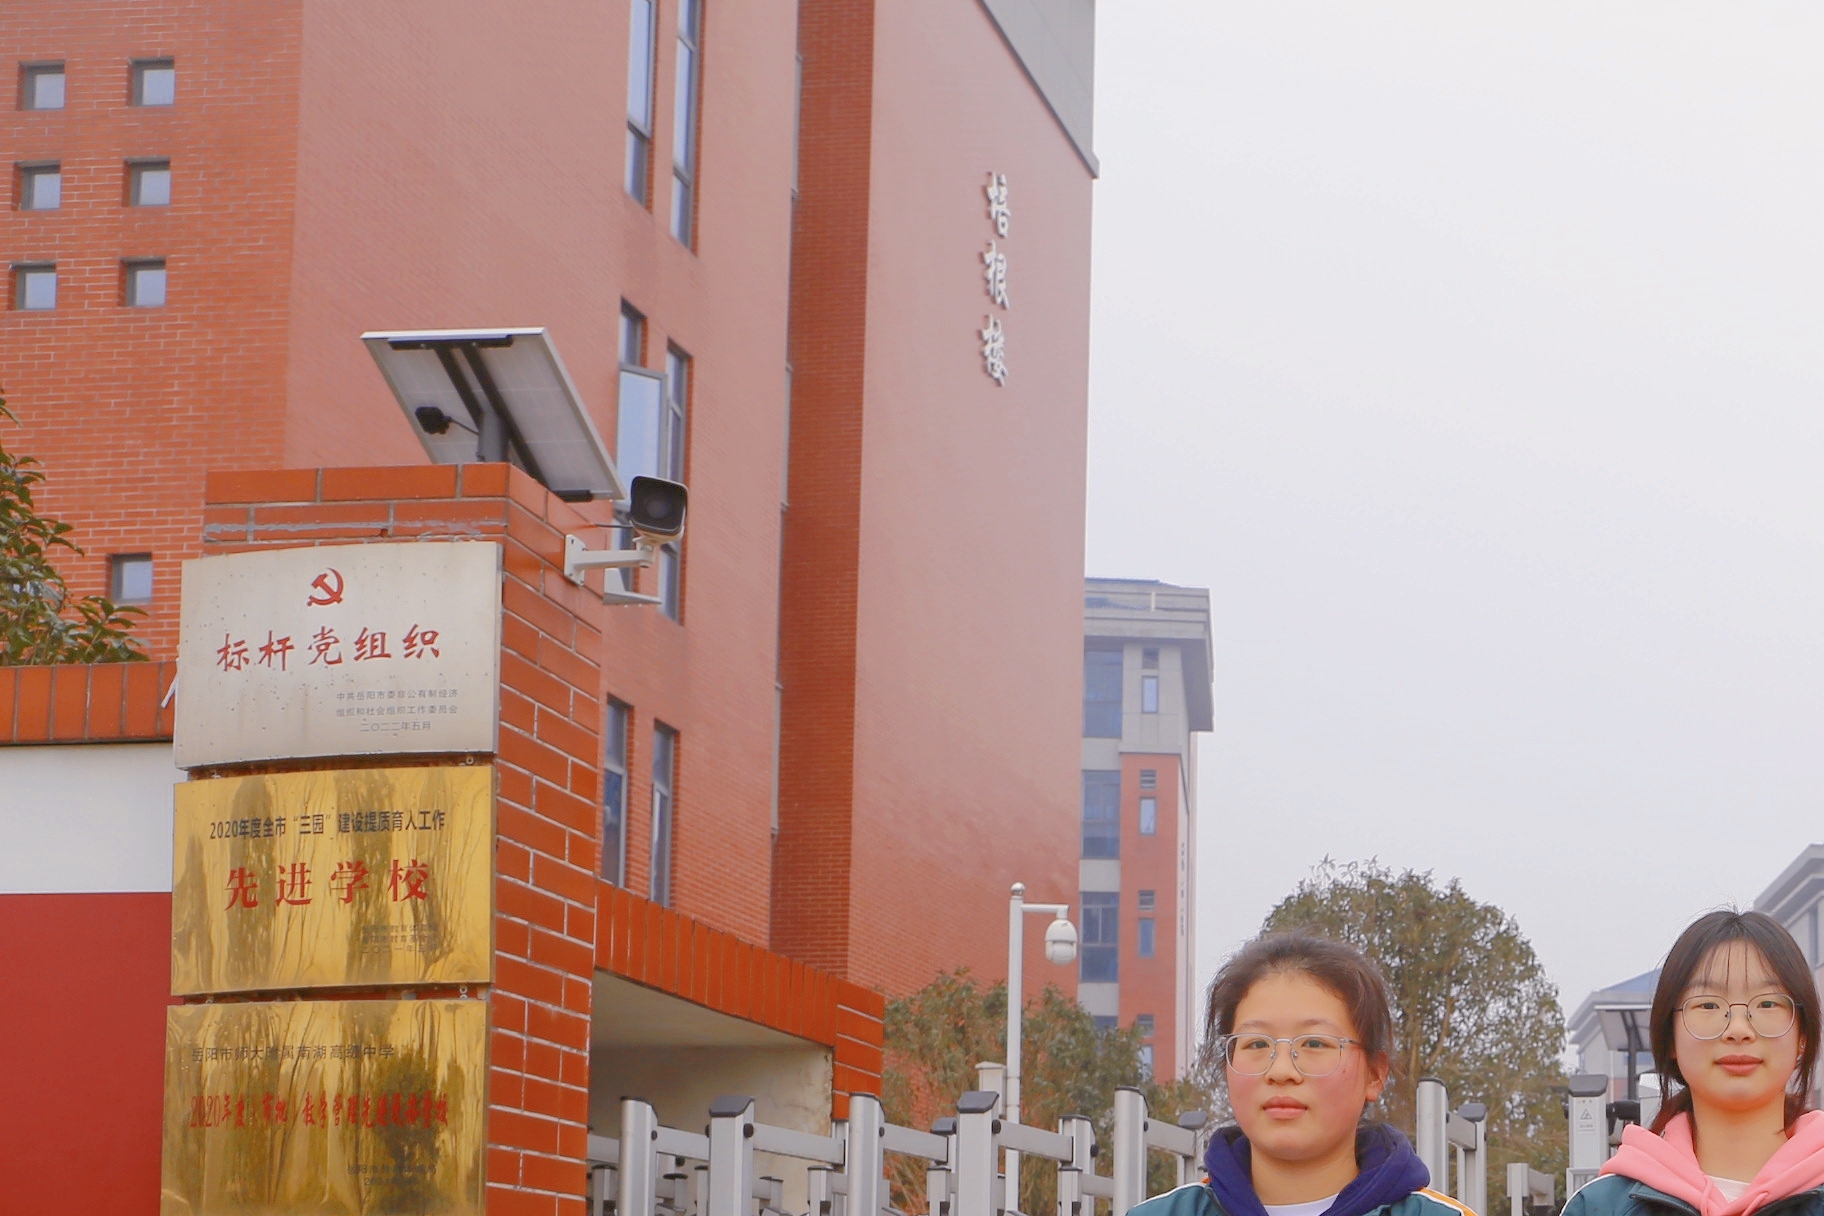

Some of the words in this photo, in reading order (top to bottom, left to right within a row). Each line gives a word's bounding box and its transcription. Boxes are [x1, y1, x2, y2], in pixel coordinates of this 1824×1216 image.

[216, 624, 440, 672] 标杆党组织
[224, 858, 430, 912] 先进学校
